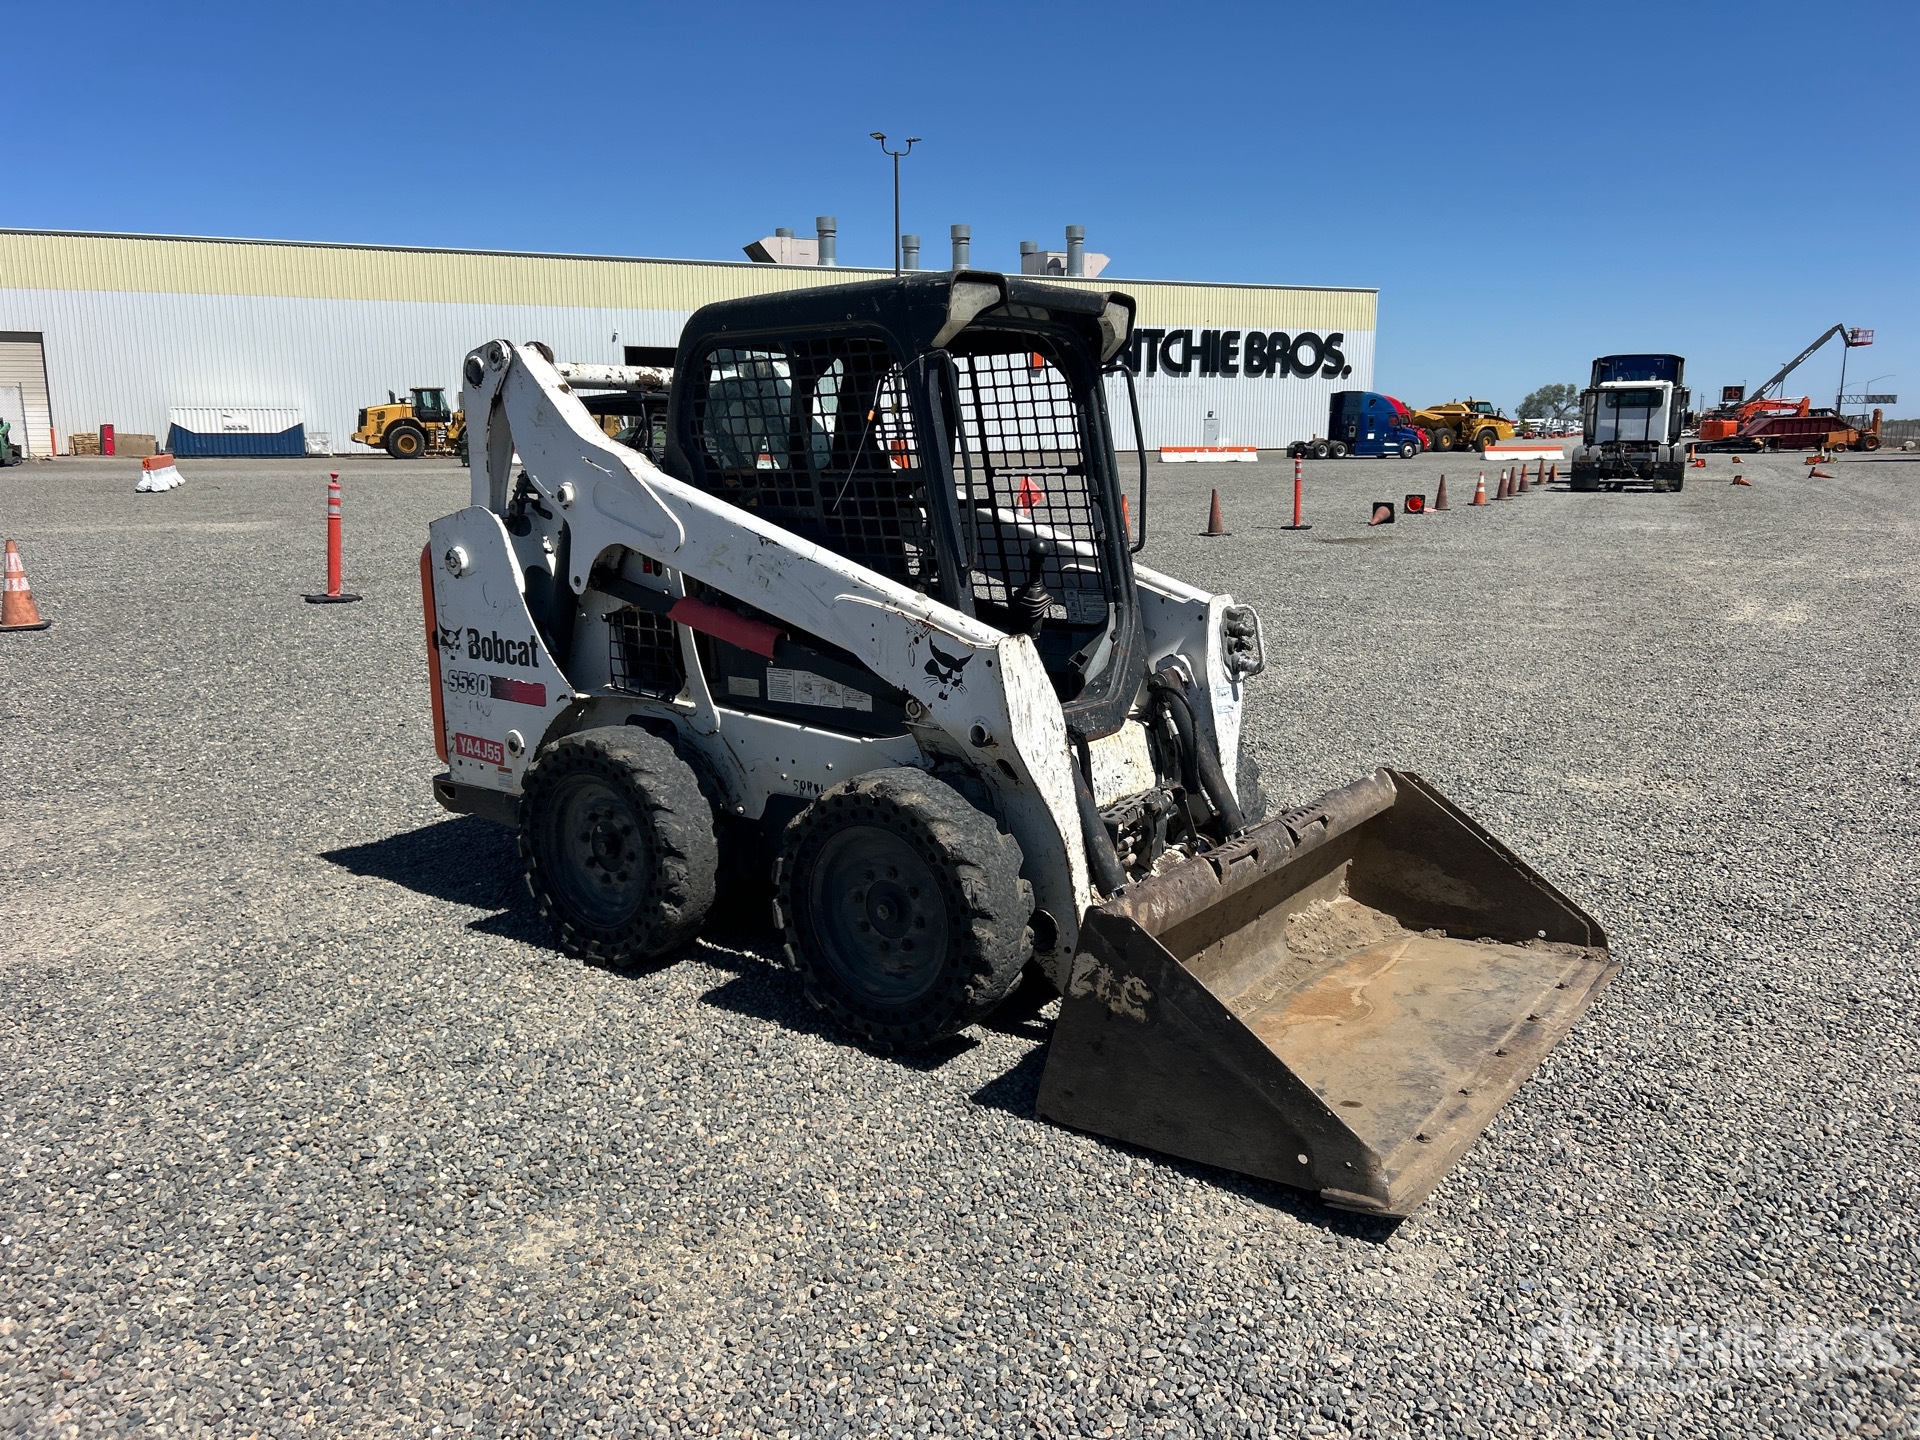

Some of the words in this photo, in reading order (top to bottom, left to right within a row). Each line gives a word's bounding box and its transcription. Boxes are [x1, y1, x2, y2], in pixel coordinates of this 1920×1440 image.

[1245, 331, 1352, 378] BROS.
[1725, 387, 1740, 398] rb
[467, 628, 539, 668] Bobcat
[448, 669, 489, 697] S530
[460, 736, 502, 762] YA4J55
